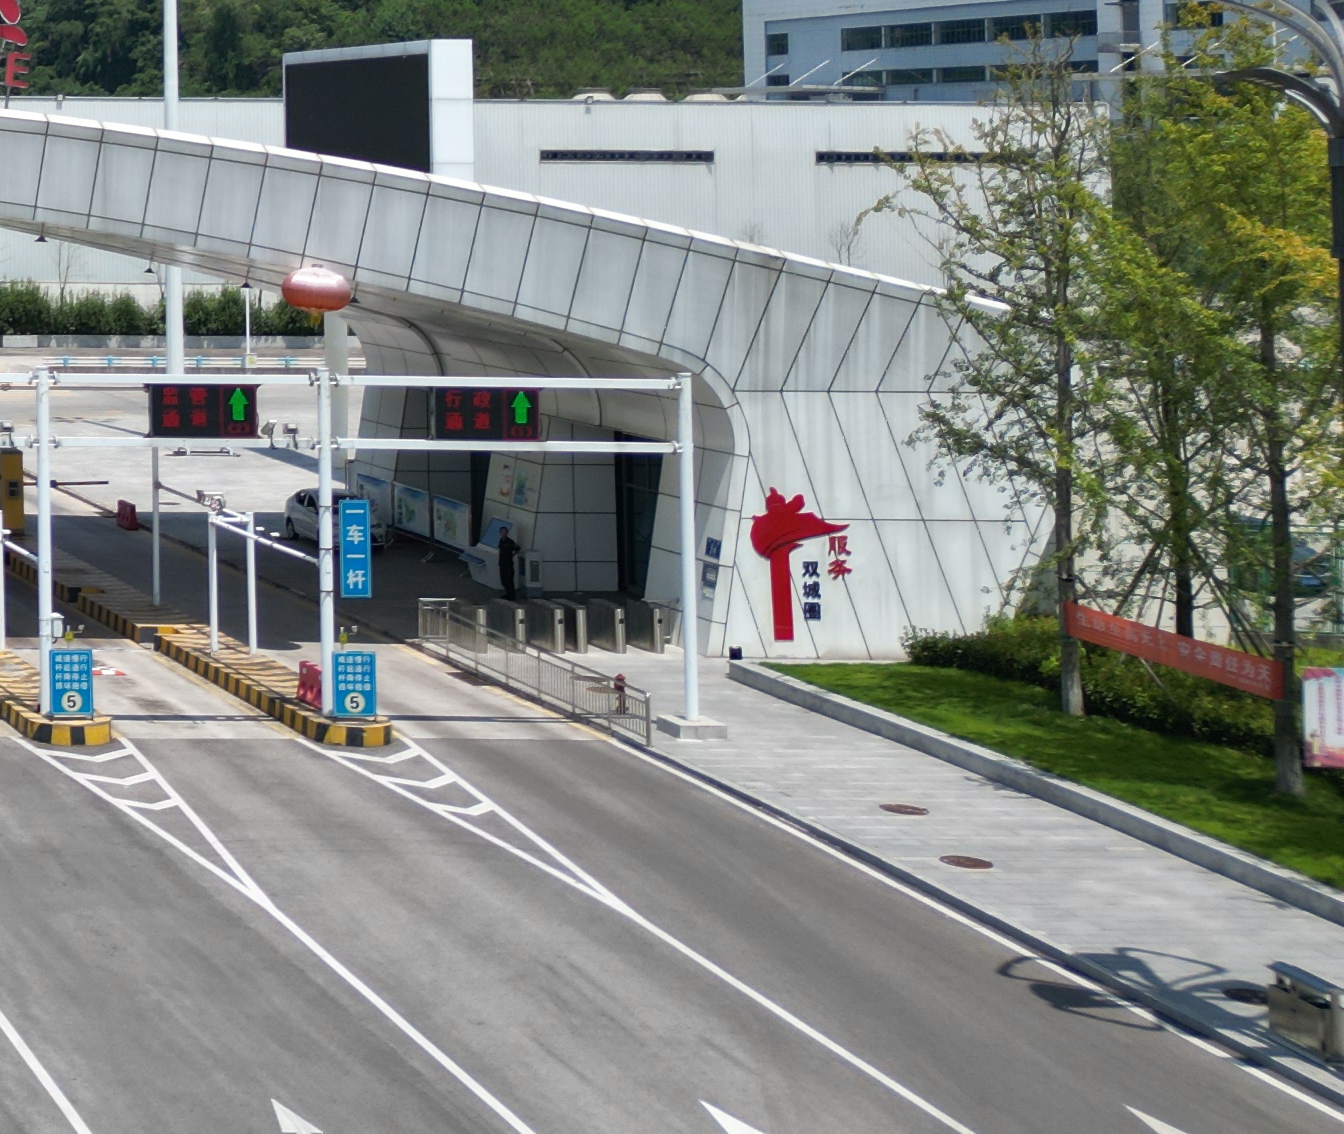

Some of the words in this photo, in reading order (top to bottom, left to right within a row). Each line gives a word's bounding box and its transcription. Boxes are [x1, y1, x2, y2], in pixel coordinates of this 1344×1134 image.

[444, 390, 492, 409] 行政
[345, 509, 366, 590] 一车一杆
[827, 535, 852, 581] 服务
[802, 560, 822, 621] 双城圈
[67, 695, 76, 708] 5
[350, 696, 359, 709] 5
